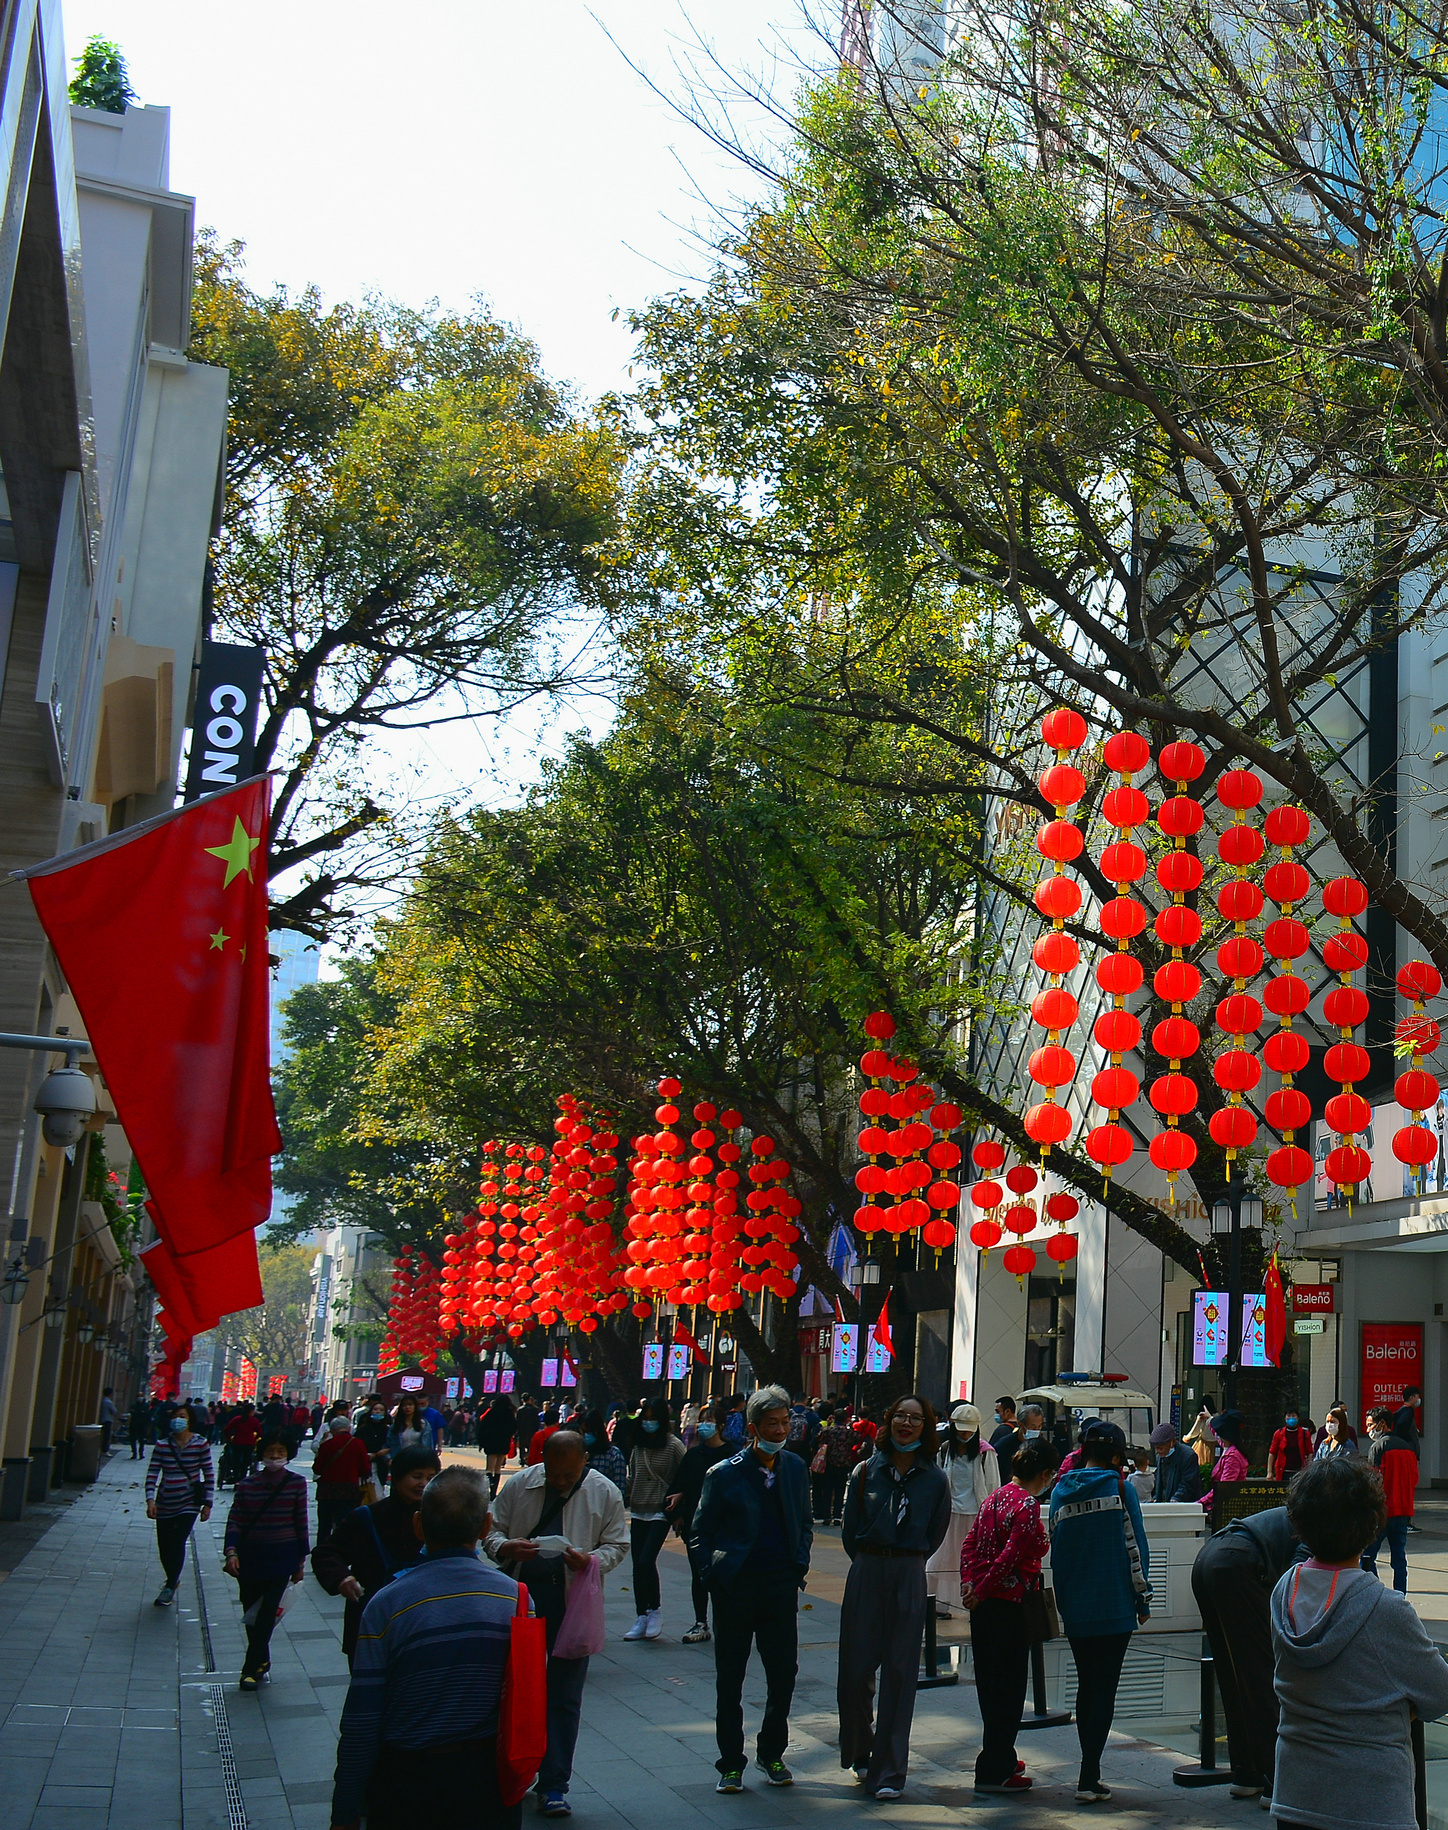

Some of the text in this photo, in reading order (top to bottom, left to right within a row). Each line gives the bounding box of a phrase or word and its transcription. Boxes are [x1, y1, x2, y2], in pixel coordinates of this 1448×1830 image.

[202, 684, 247, 792] CON
[1296, 1293, 1330, 1304] Baleno
[1366, 1343, 1417, 1359] Baleno
[1240, 1487, 1290, 1495] 北京路古道
